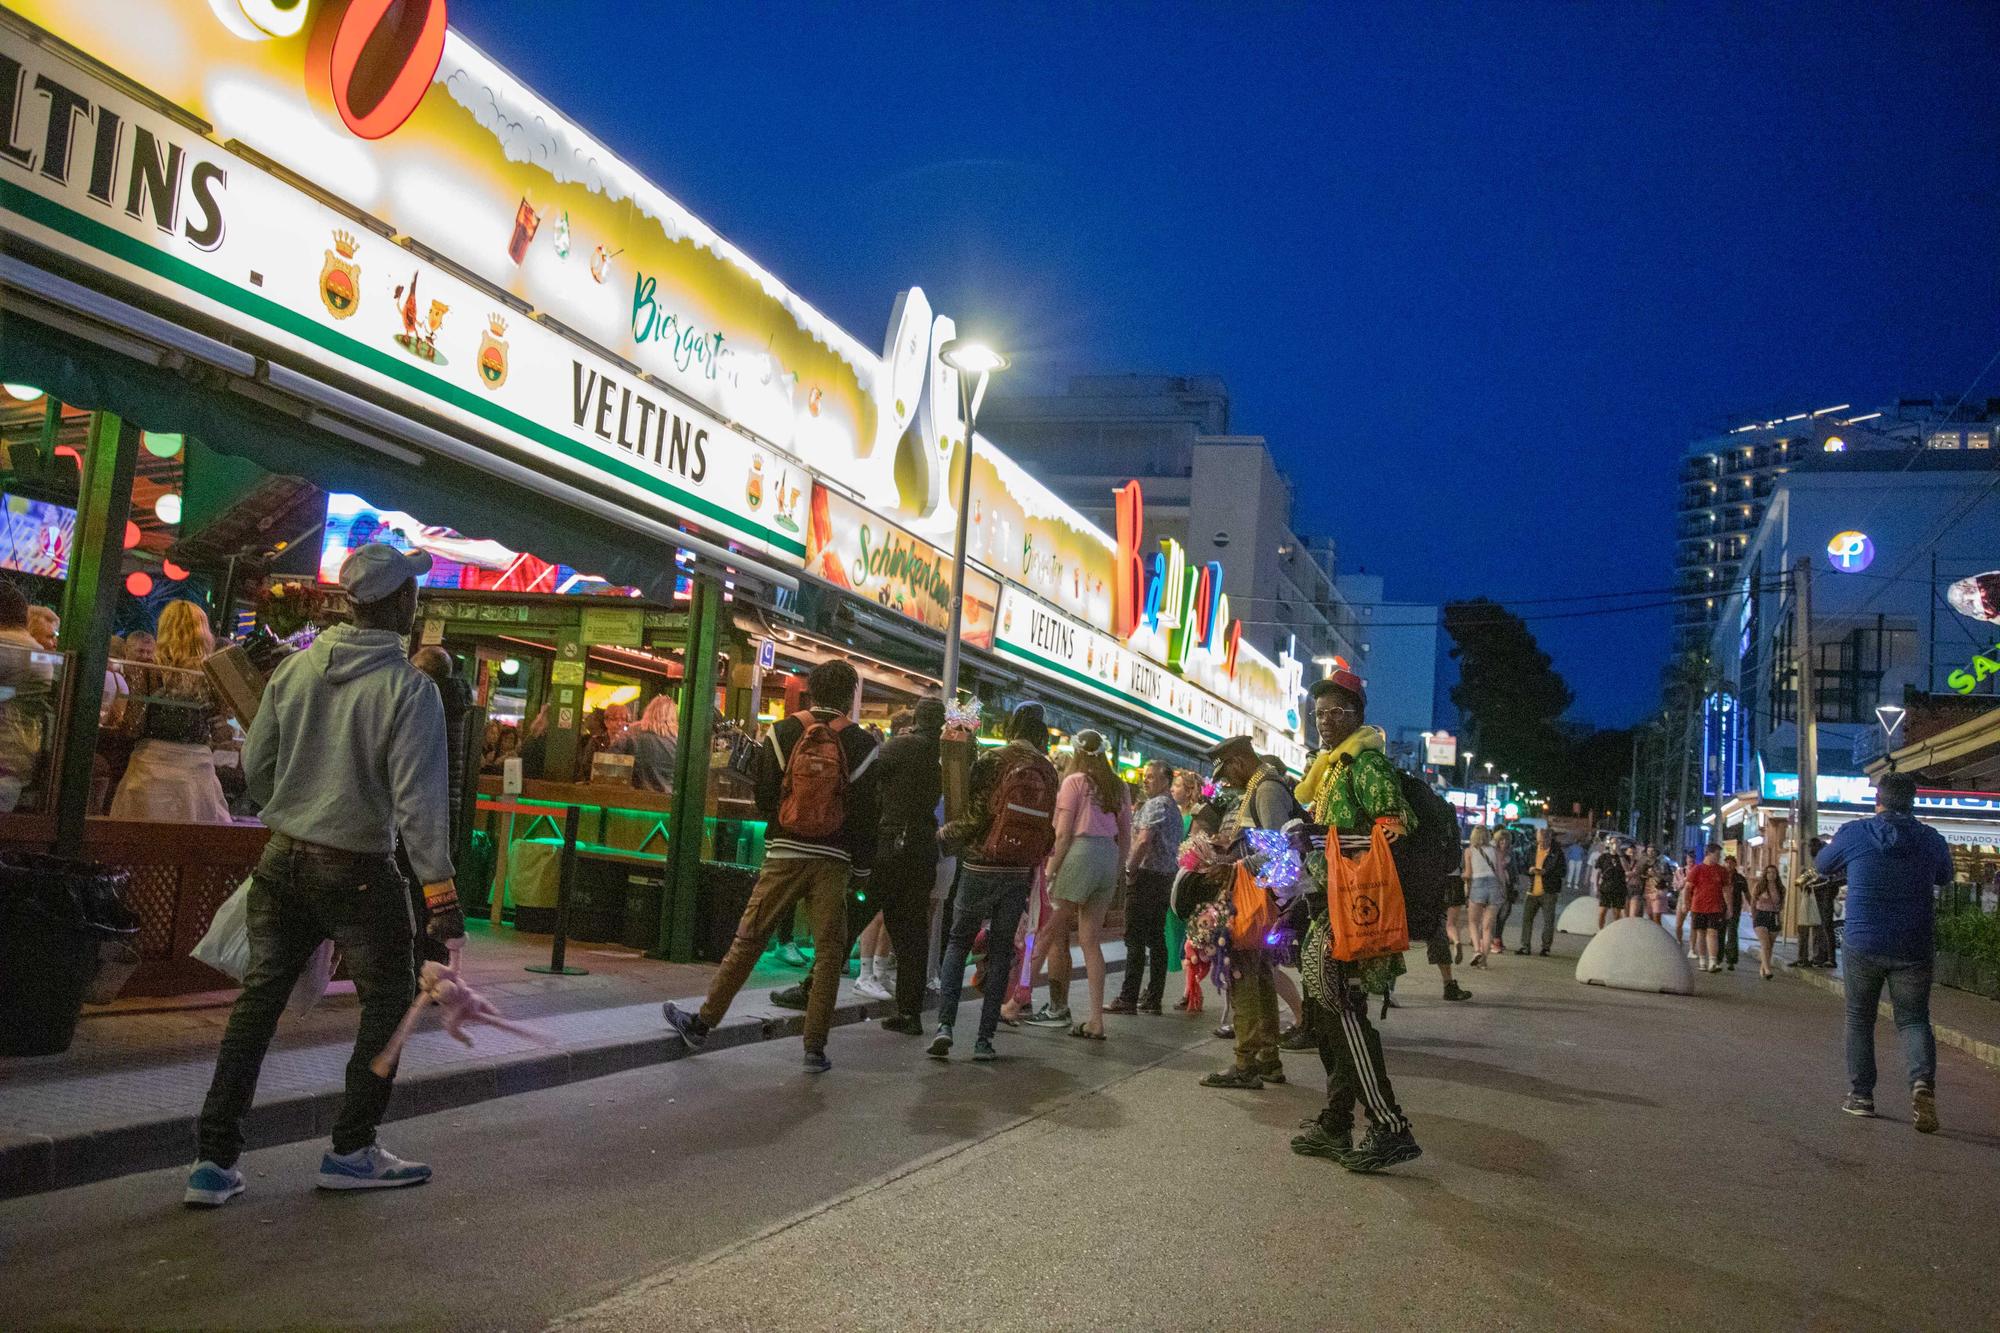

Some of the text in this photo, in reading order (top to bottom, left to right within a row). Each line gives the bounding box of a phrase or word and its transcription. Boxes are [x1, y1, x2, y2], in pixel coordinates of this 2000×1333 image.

[571, 359, 709, 486] VELTINS
[1029, 608, 1075, 660] VELTINS
[1131, 660, 1161, 700] VELTINS
[1947, 642, 2000, 695] SA
[1948, 834, 1992, 844] FUNDADO
